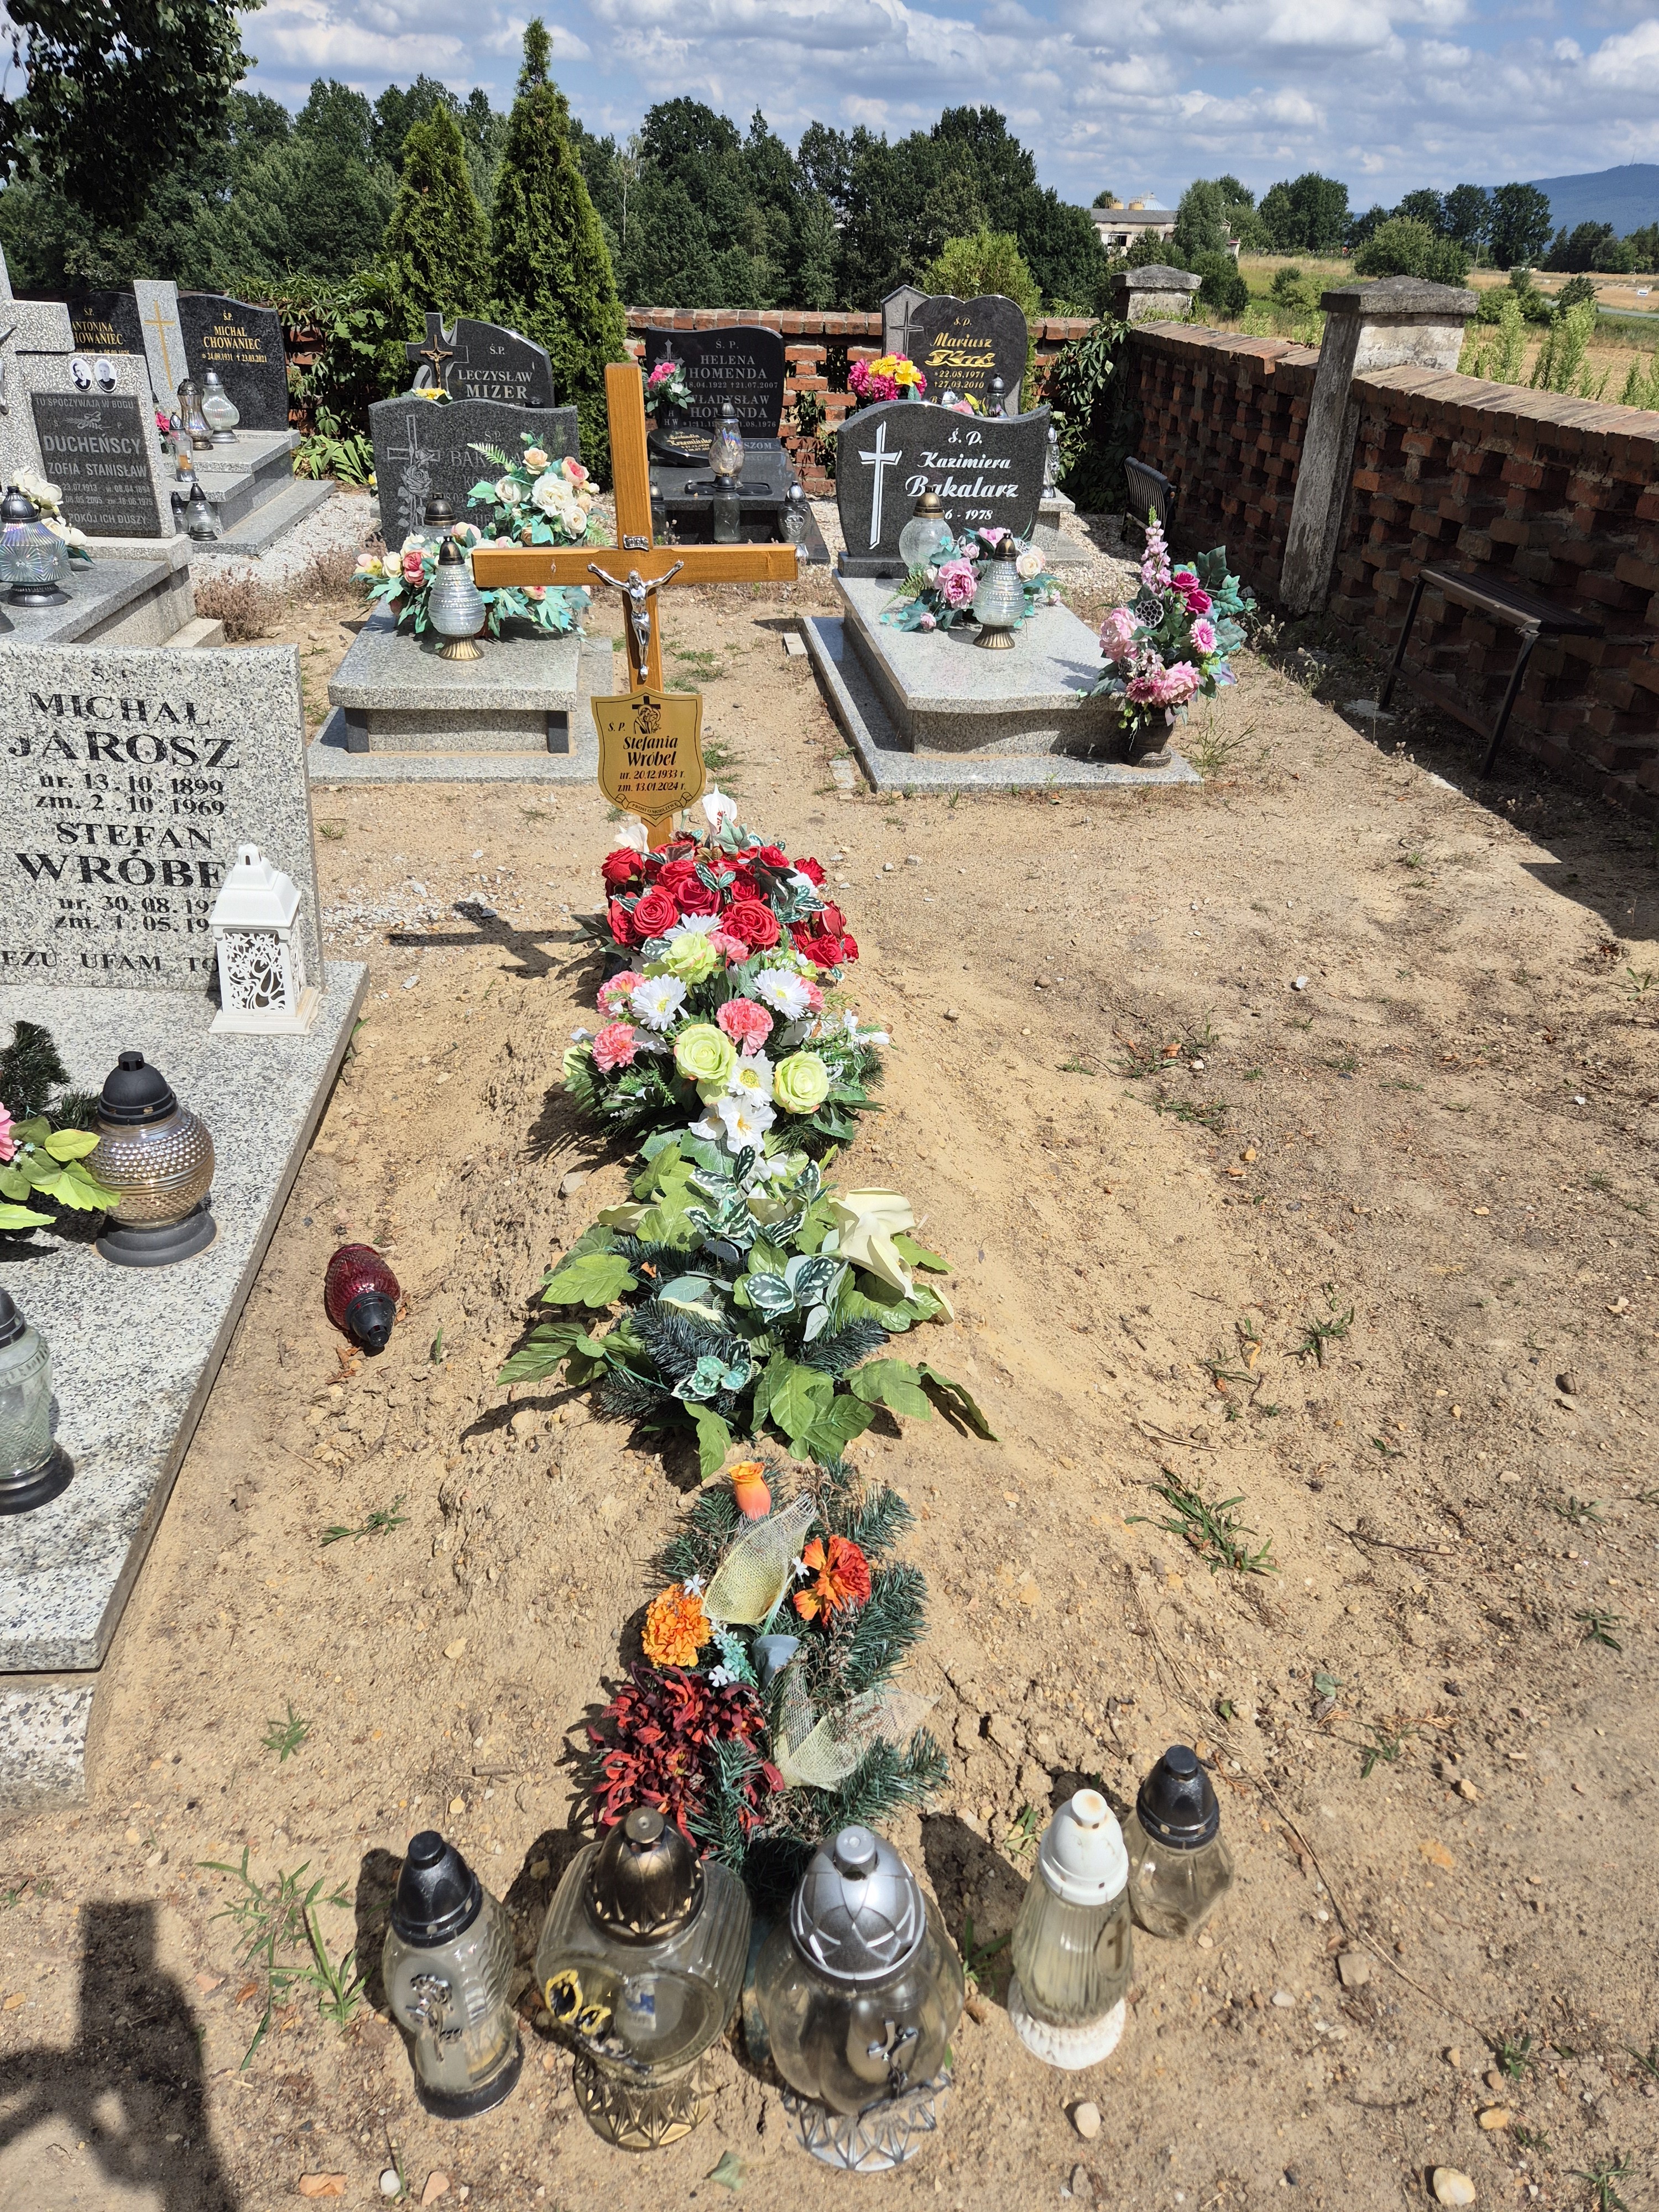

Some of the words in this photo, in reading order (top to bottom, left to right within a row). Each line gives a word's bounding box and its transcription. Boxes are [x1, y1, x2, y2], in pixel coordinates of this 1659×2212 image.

[72, 321, 114, 332] ANTONINA
[74, 332, 124, 345] HOWANIEC
[204, 336, 262, 350] CHOWANIEC
[930, 332, 993, 348] Mariusz
[700, 354, 755, 365] HELENA
[689, 368, 768, 379] HOMENDA
[466, 384, 528, 399] MIZER
[35, 398, 45, 406] TU
[48, 398, 100, 409] SPOCZYWAJĄ
[102, 399, 109, 408] W
[112, 400, 134, 409] BOGU
[690, 407, 768, 418] HONDA
[43, 434, 140, 455] DUCHEŃSCY
[917, 451, 1011, 469] Kazimiera
[48, 462, 81, 475] ZOFIA
[86, 463, 147, 477] STANISŁAW
[68, 512, 97, 522] POKÓJ
[100, 514, 115, 523] ICH
[117, 514, 147, 524] DUSZY
[965, 509, 993, 520] 1978
[27, 692, 210, 725] MICHAŁ
[8, 728, 239, 769] JAROSZ
[623, 735, 679, 752] Stefania
[627, 751, 677, 767] Wróbel
[39, 774, 74, 789] ur.
[619, 771, 631, 780] ur.
[633, 769, 678, 780] 20.12.1933
[617, 784, 633, 792] zm.
[635, 782, 679, 792] 13.01.2024
[680, 782, 686, 791] r.
[35, 795, 81, 810] zm.
[632, 803, 647, 812] PROSI
[651, 802, 679, 814] MODLITWĘ
[56, 822, 214, 850] STEFAN
[15, 849, 227, 889] WRÓBE
[58, 897, 92, 911] ur.
[55, 915, 100, 930] zm.
[0, 950, 58, 968] EZU
[80, 953, 162, 971] UFAM
[183, 957, 220, 973] TO
